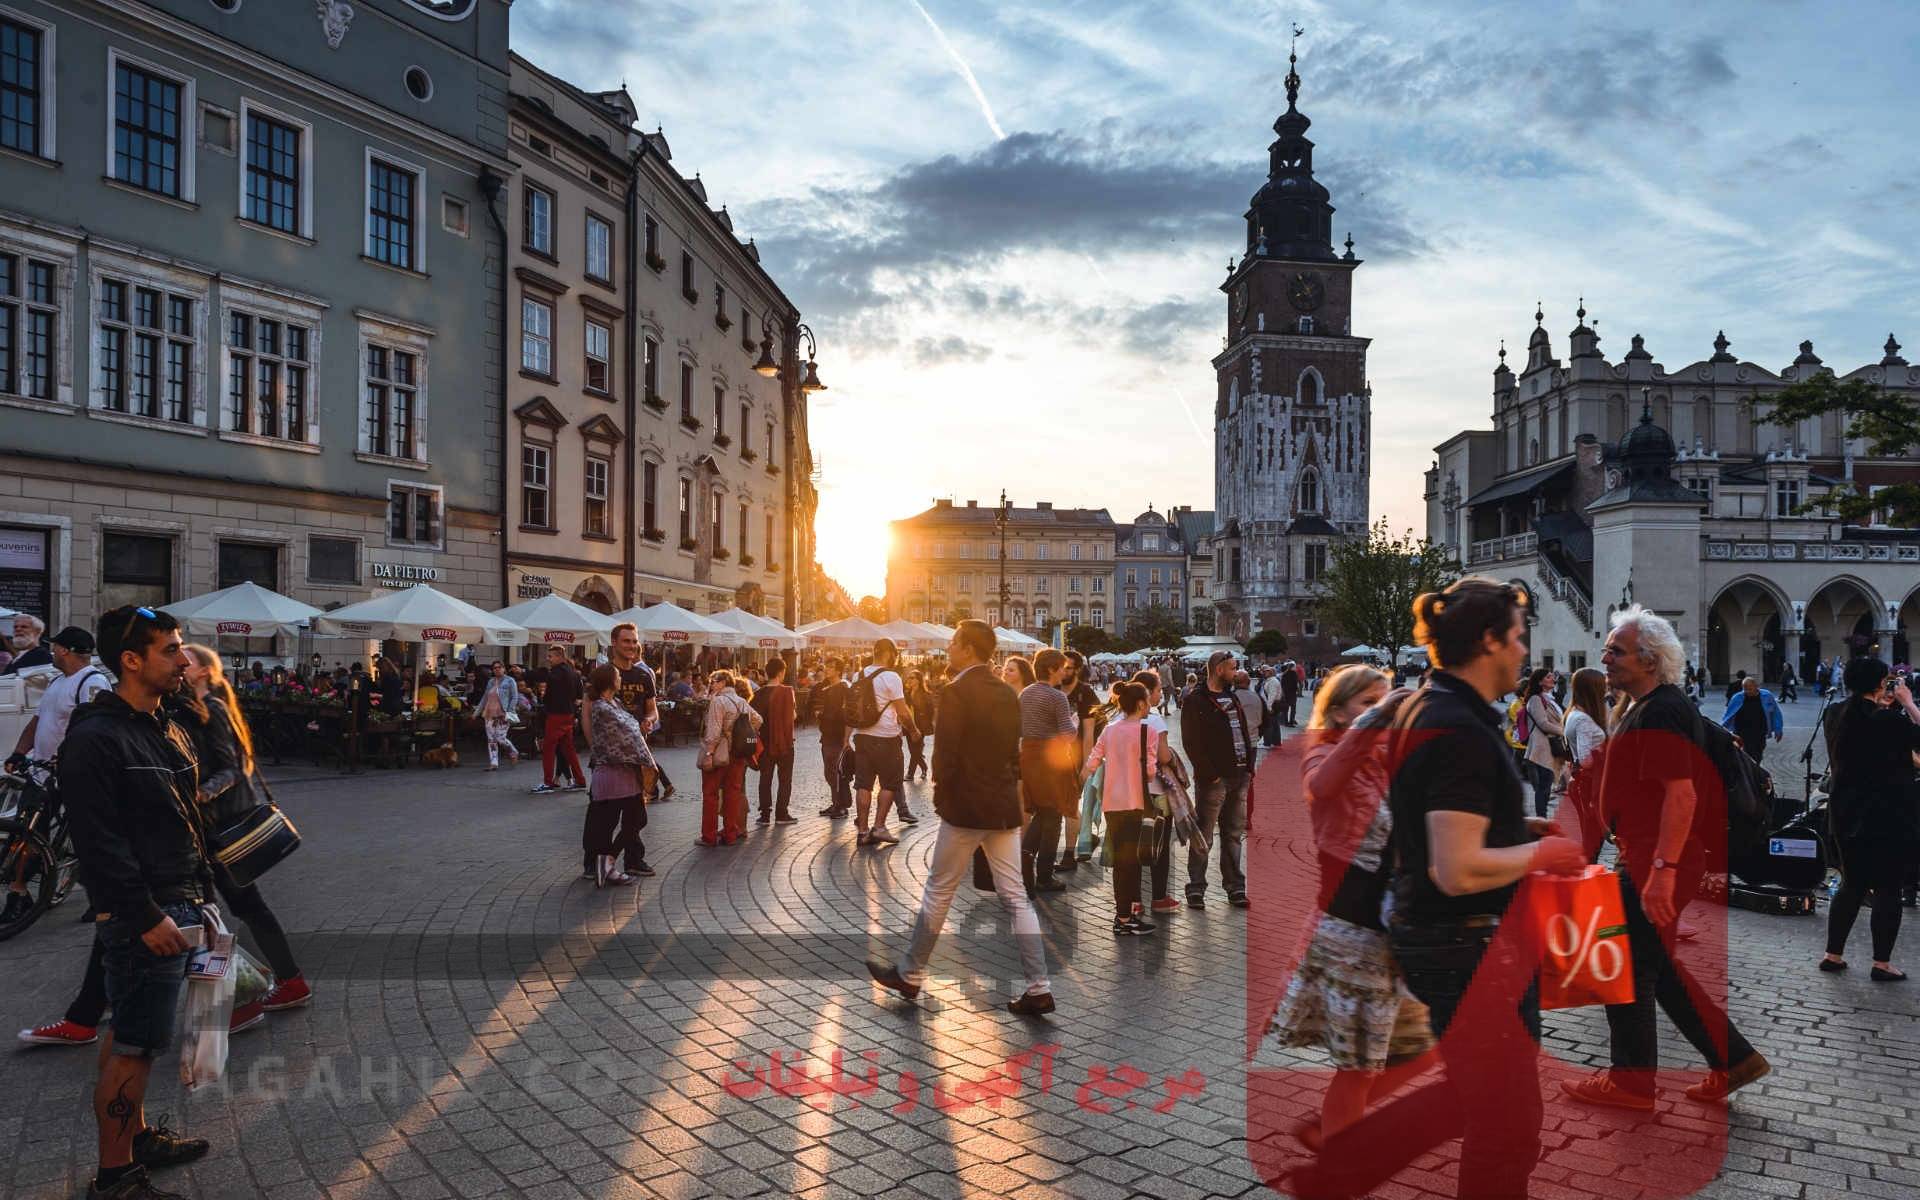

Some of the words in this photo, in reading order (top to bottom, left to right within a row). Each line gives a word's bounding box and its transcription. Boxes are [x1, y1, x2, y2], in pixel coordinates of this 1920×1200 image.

[0, 544, 40, 552] uvenirs
[374, 563, 391, 577] DA
[394, 565, 438, 580] PIETRO
[382, 579, 426, 588] restaura
